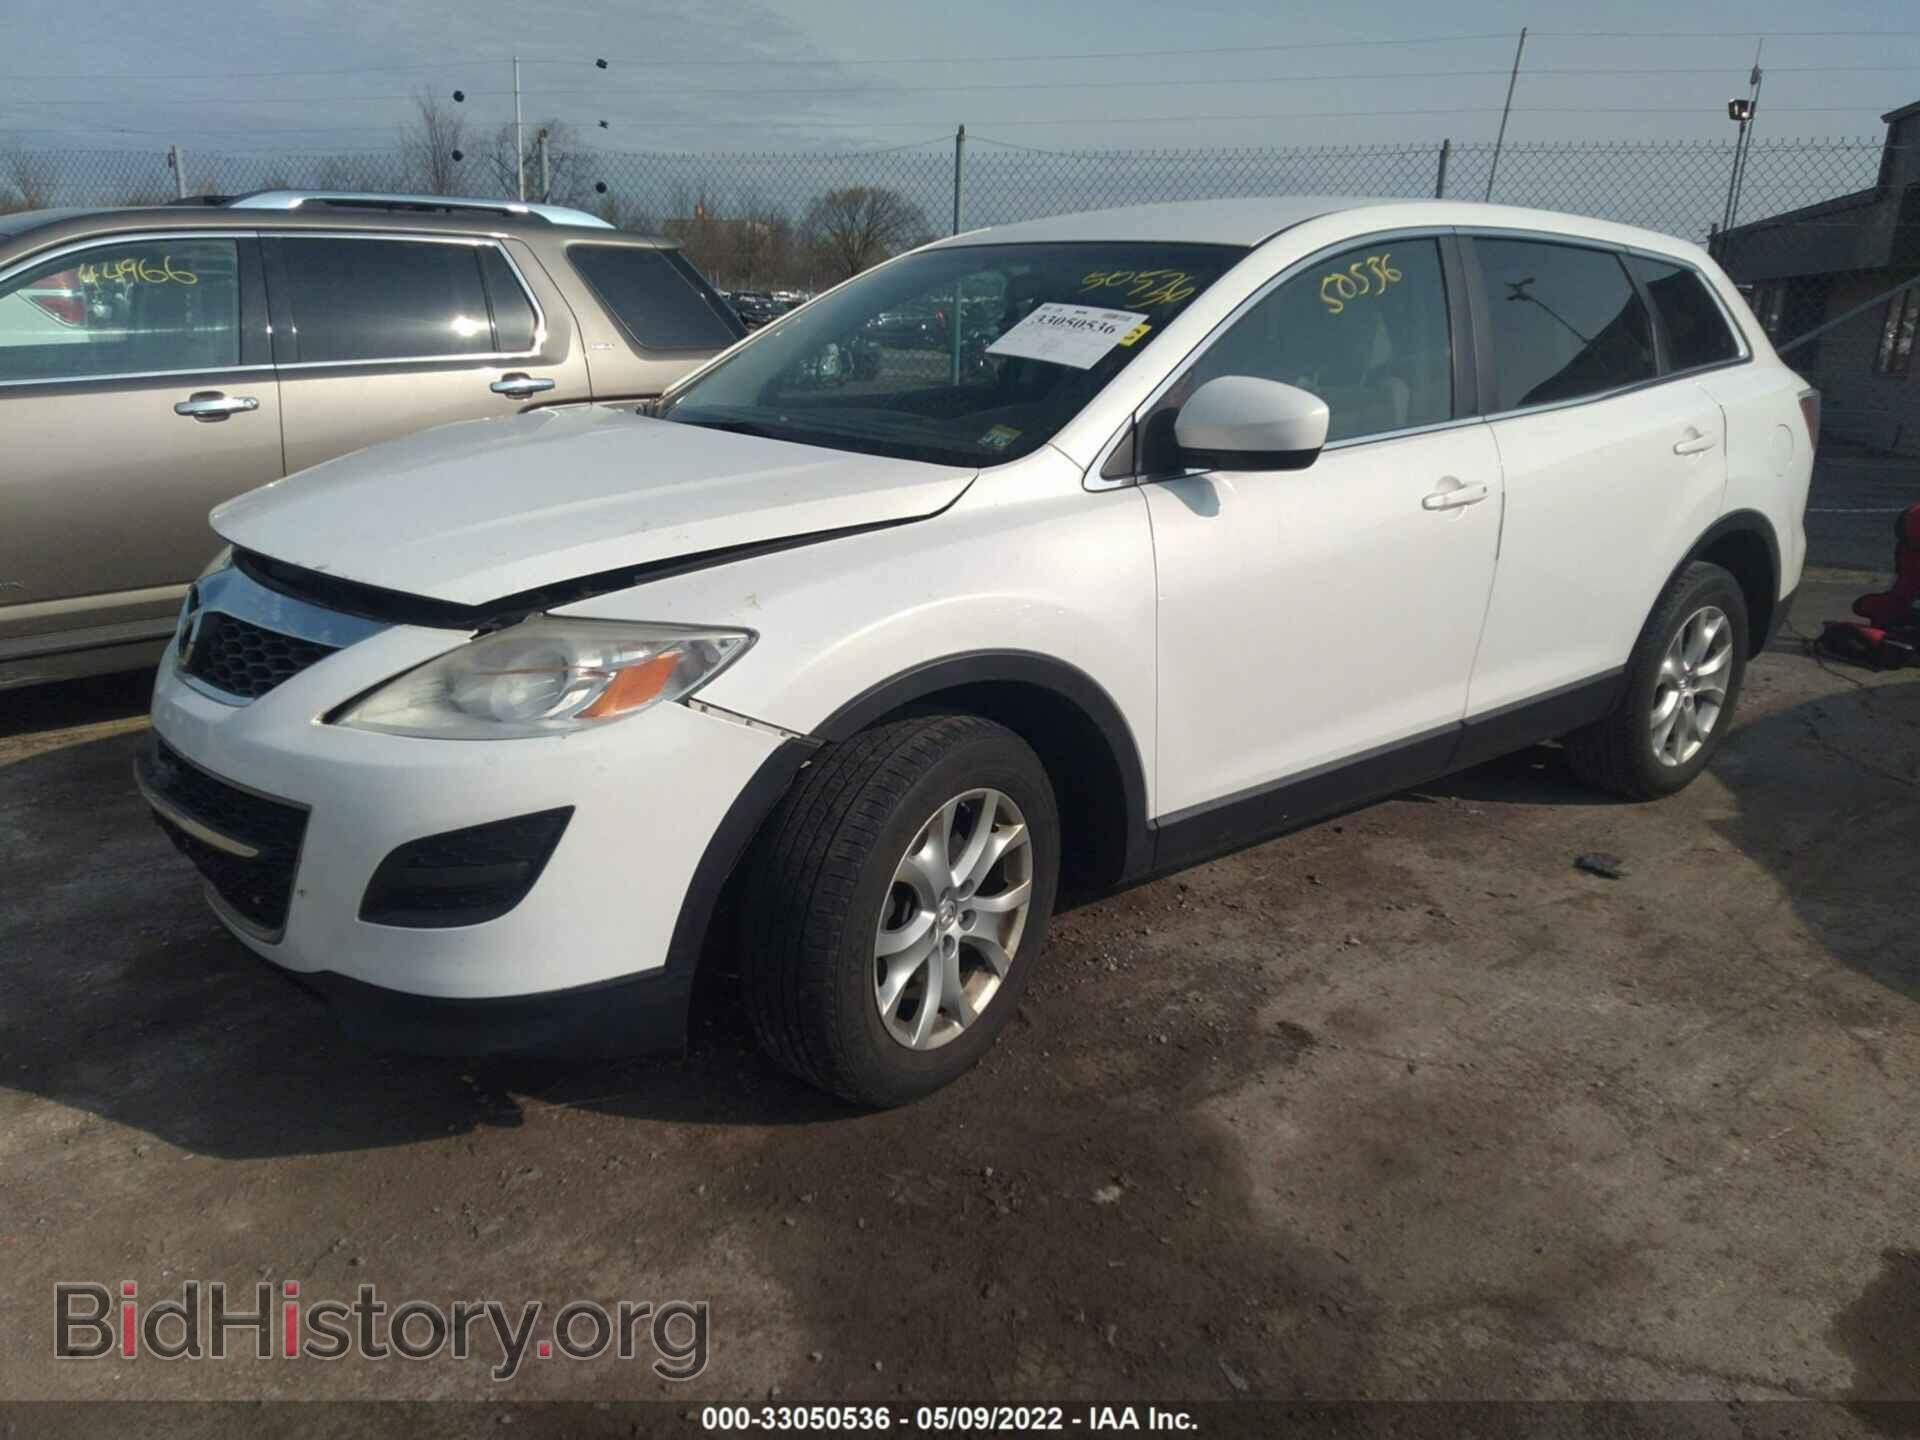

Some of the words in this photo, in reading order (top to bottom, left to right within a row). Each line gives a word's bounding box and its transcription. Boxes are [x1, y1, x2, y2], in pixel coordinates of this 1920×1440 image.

[78, 256, 198, 286] 44966
[1321, 254, 1402, 313] 50536
[1036, 312, 1117, 335] 33050536
